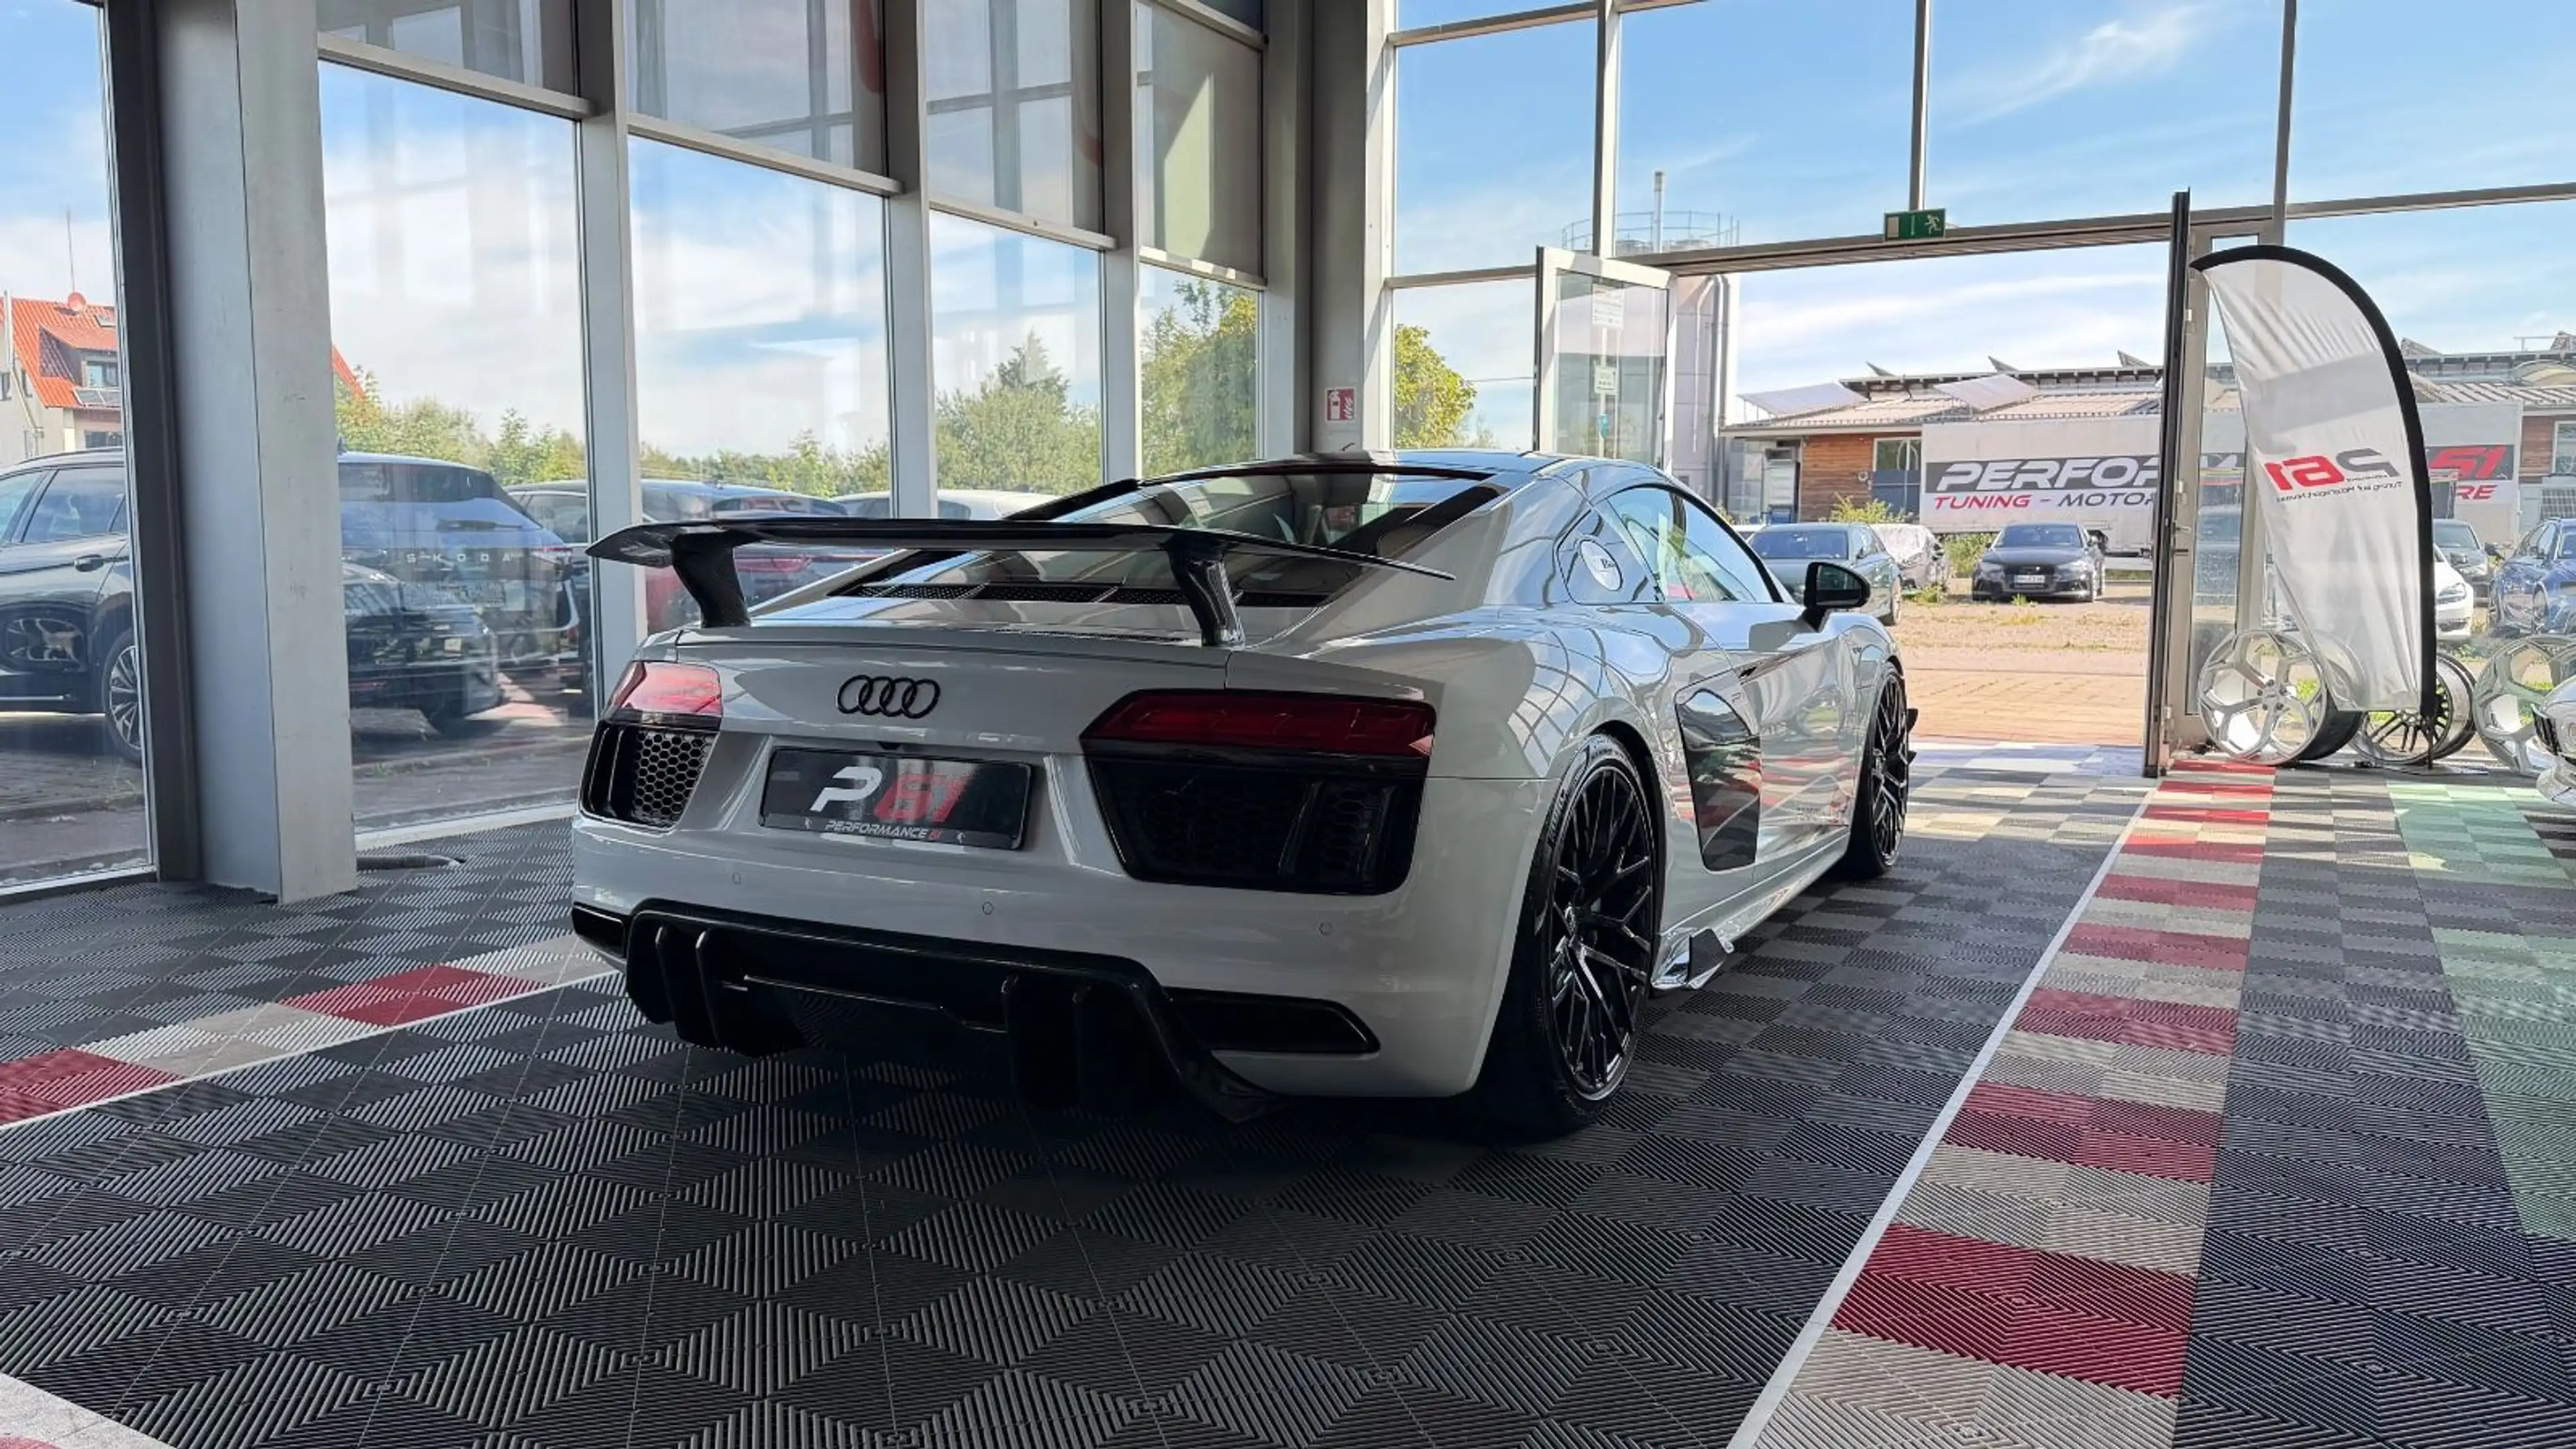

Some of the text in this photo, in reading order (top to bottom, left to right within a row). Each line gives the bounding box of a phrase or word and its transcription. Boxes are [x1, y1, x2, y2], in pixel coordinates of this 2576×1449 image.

[1935, 494, 2033, 510] TUNING
[809, 765, 970, 823] P61
[825, 820, 928, 839] PERFORMANCE
